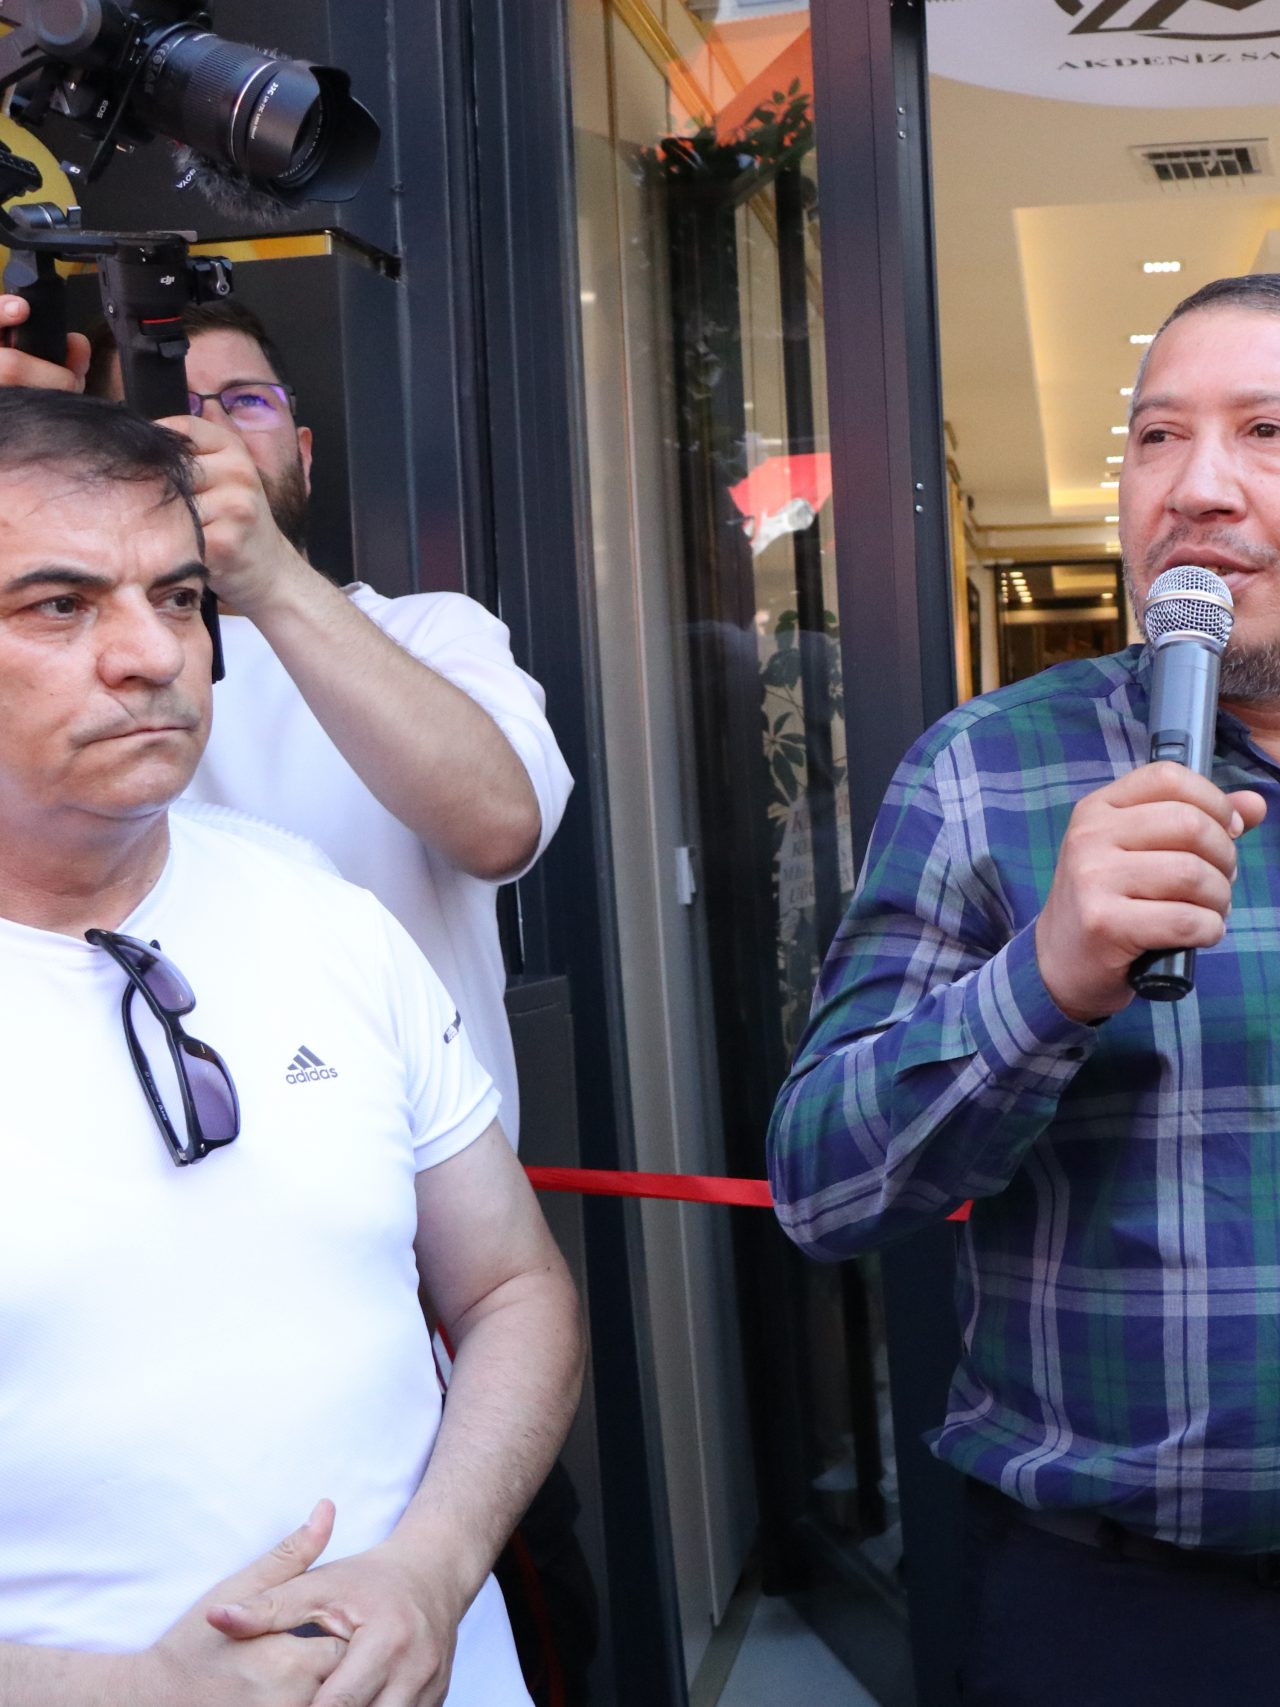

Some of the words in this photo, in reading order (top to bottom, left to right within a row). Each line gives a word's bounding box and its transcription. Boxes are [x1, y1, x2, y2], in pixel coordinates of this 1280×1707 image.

[1057, 52, 1231, 71] AKDENİZ
[96, 99, 109, 119] EOS
[176, 168, 197, 189] BOYA
[285, 1066, 339, 1085] adidas
